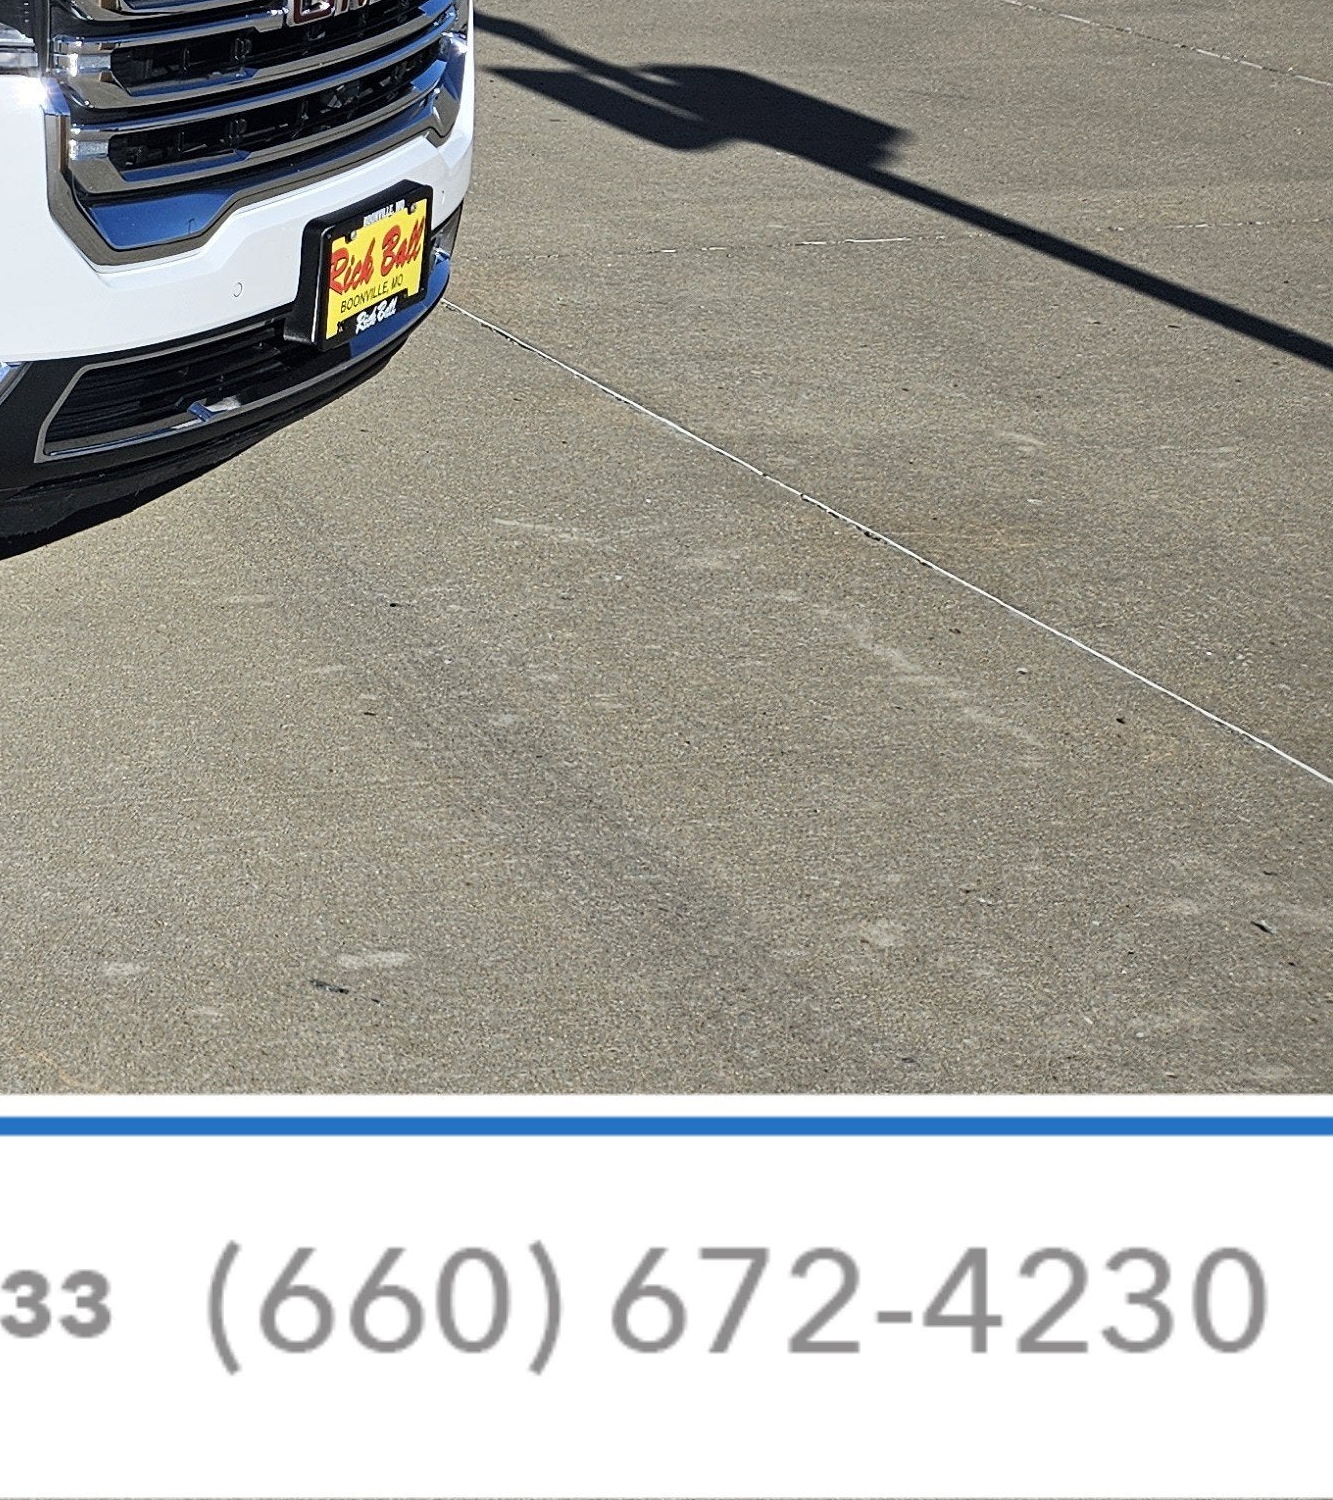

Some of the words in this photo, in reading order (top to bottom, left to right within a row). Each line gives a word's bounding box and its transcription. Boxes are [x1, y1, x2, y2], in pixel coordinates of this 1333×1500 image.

[329, 237, 375, 296] Rick
[380, 216, 425, 277] Ball
[340, 280, 389, 314] BOONVILLE,
[391, 273, 404, 291] MO
